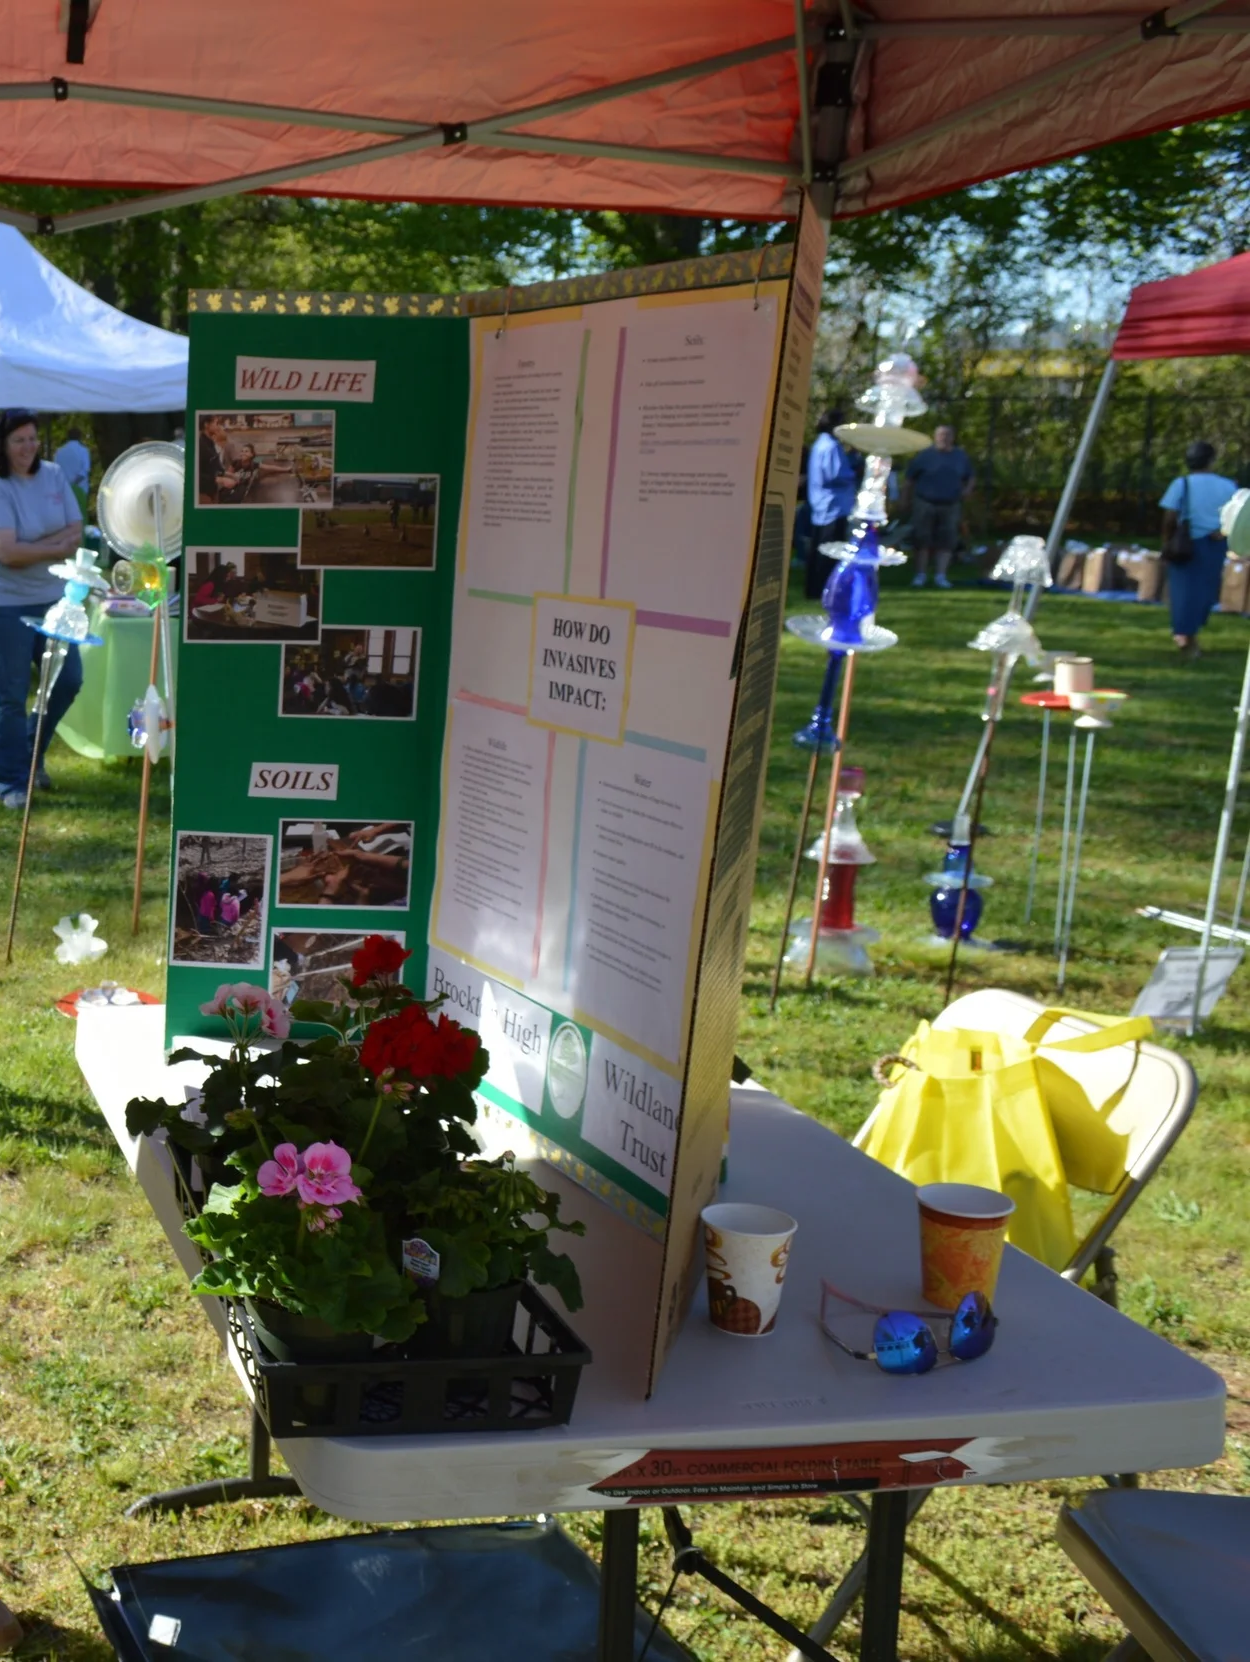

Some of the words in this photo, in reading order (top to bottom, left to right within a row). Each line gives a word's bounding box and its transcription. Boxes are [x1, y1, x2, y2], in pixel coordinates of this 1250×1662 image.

[240, 366, 303, 391] WILD
[307, 371, 367, 393] LIFE
[553, 617, 587, 640] HOW
[589, 623, 611, 645] DO
[542, 648, 617, 680] INVASIVES
[549, 680, 607, 711] IMPACT:
[254, 769, 334, 791] SOILS
[433, 965, 499, 1022] Brockt
[502, 1006, 542, 1055] High
[620, 1119, 668, 1178] Trust
[687, 1460, 778, 1476] COMMERCIAL
[783, 1456, 842, 1473] FOLDING
[846, 1457, 882, 1470] TABLE
[627, 1488, 651, 1496] Indoor
[693, 1486, 709, 1494] Easy
[767, 1483, 790, 1491] Simple
